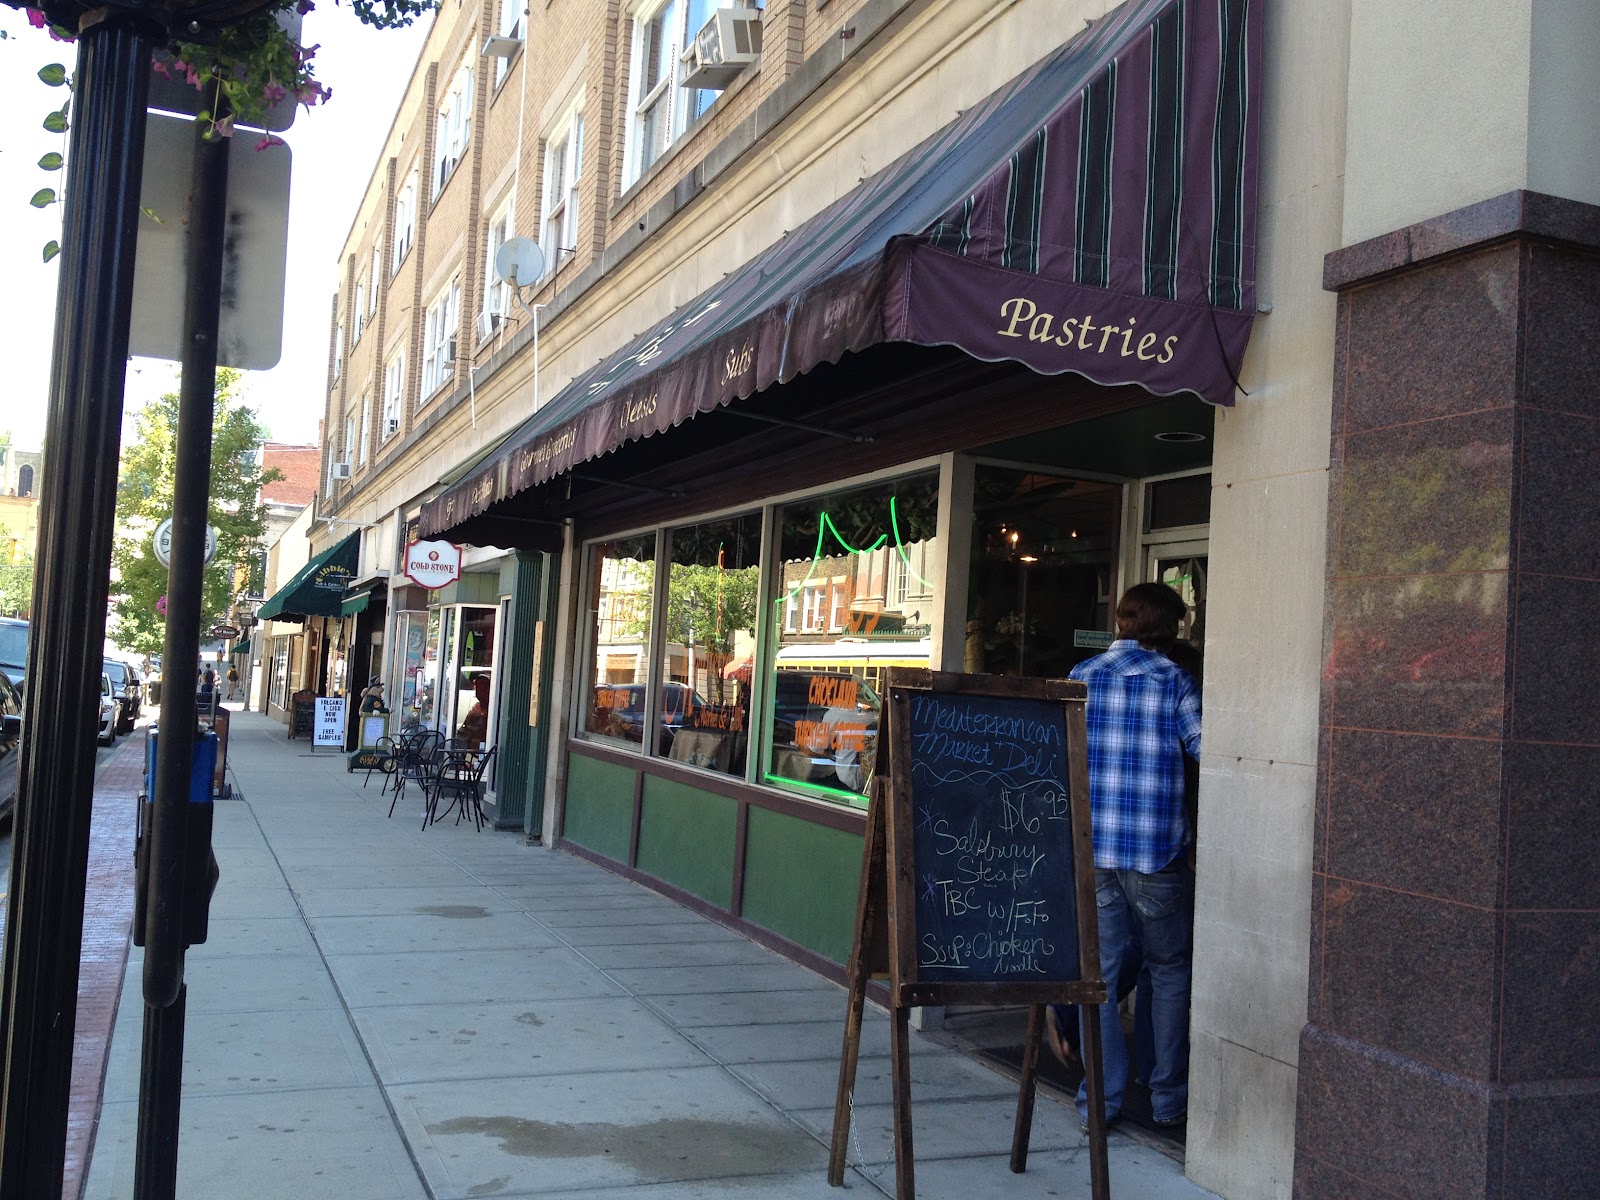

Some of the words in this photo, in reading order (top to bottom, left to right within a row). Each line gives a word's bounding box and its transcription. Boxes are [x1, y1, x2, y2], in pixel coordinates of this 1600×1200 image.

[997, 297, 1179, 364] Pastries
[721, 337, 754, 386] Subs
[410, 561, 430, 571] COLD
[430, 562, 455, 574] STONE
[1001, 741, 1059, 778] Deli
[956, 855, 1029, 891] Steak
